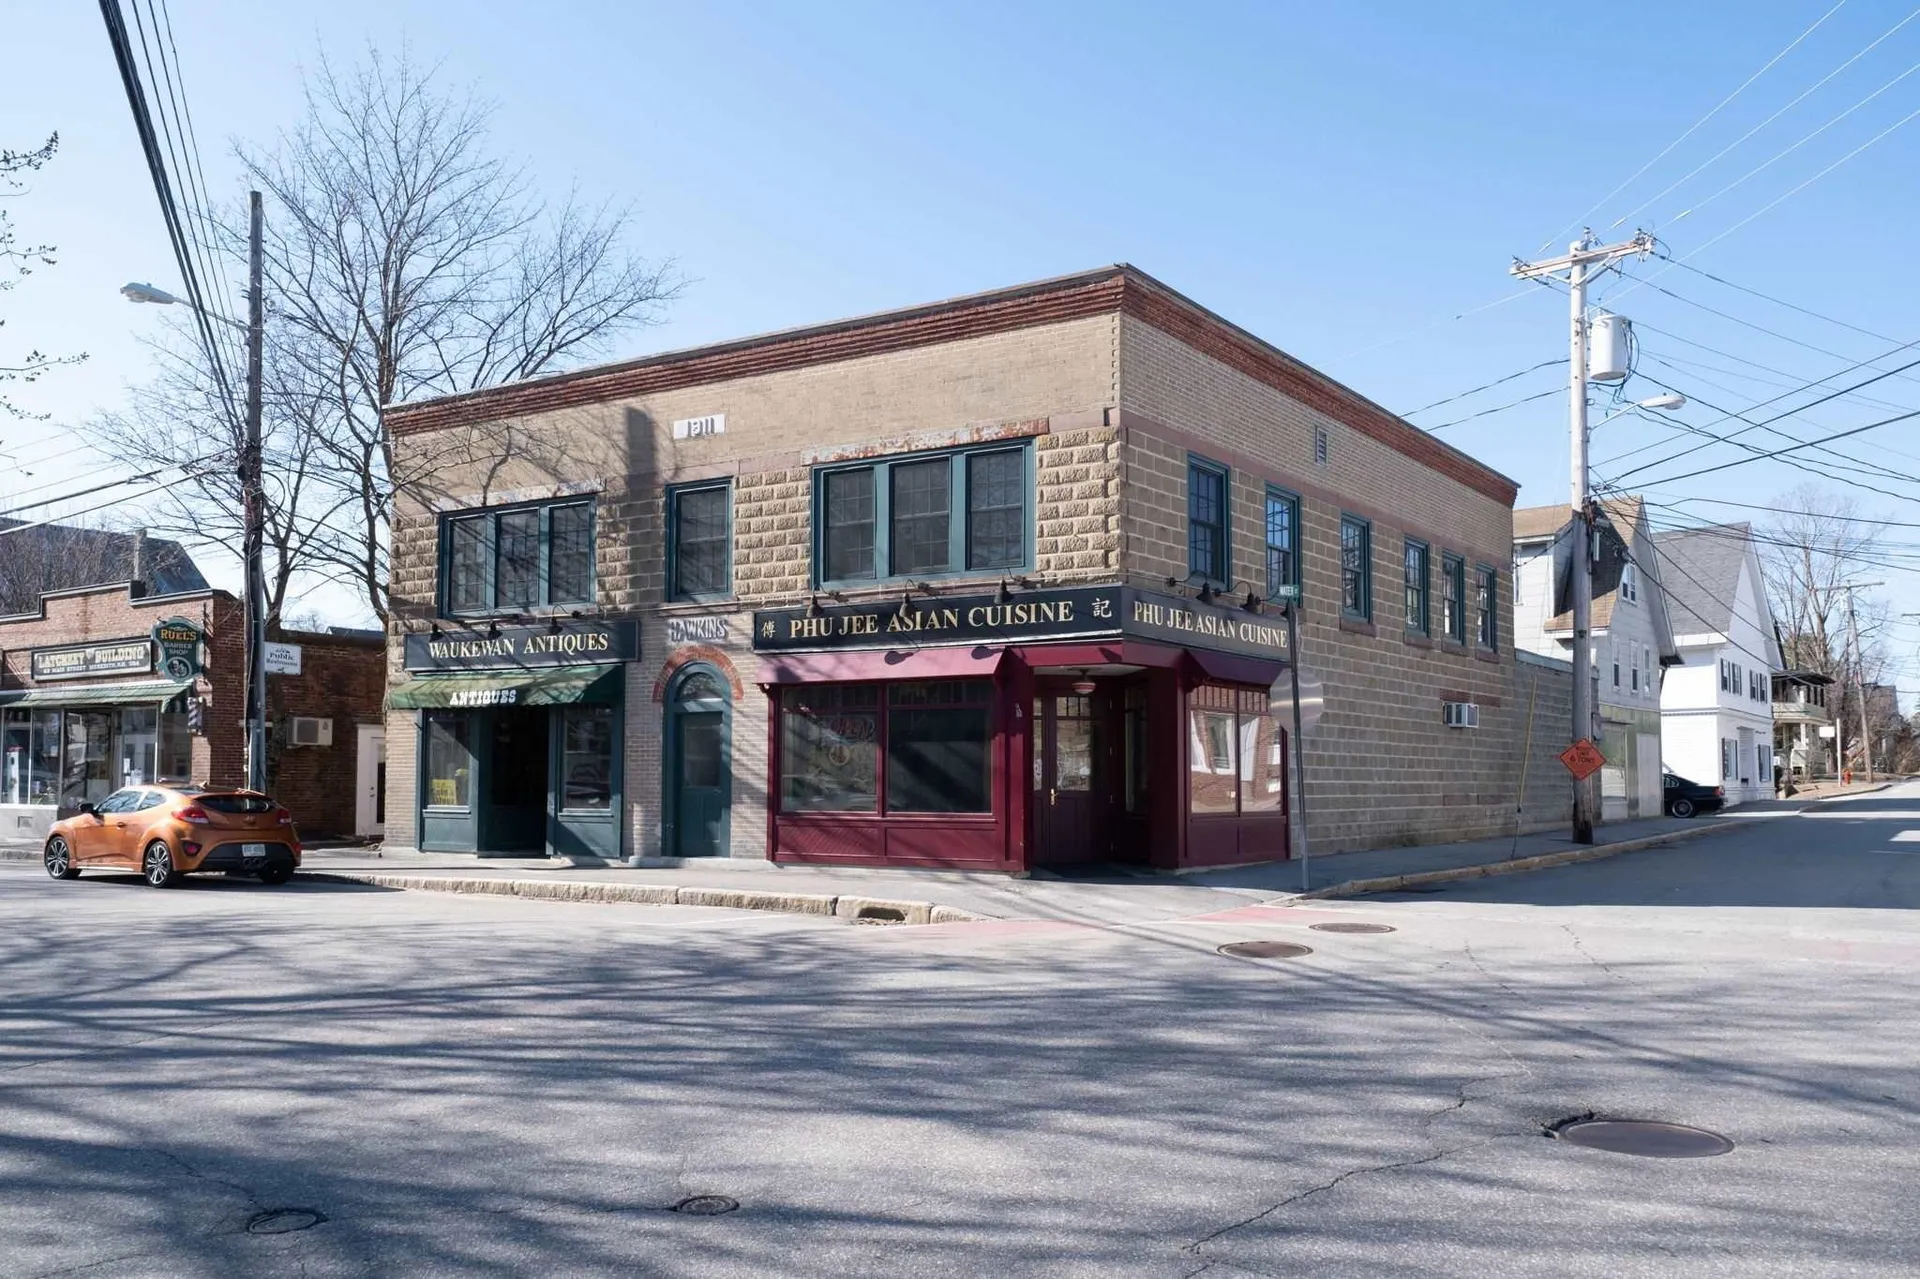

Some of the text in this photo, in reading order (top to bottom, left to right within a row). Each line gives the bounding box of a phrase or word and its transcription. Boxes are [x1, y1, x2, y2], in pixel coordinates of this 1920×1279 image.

[687, 418, 715, 437] 1911
[1092, 597, 1112, 618] 記
[669, 616, 727, 640] HAWKINS
[790, 601, 1074, 638] PHU JEE ASIAN CUISINE
[1133, 601, 1288, 648] PHU JEE ASIAN CUISINE
[94, 644, 145, 663] BUILDING
[270, 651, 294, 661] Public
[429, 633, 609, 658] WAUKEWAN ANTIQUES
[449, 690, 517, 705] ANTIQUES
